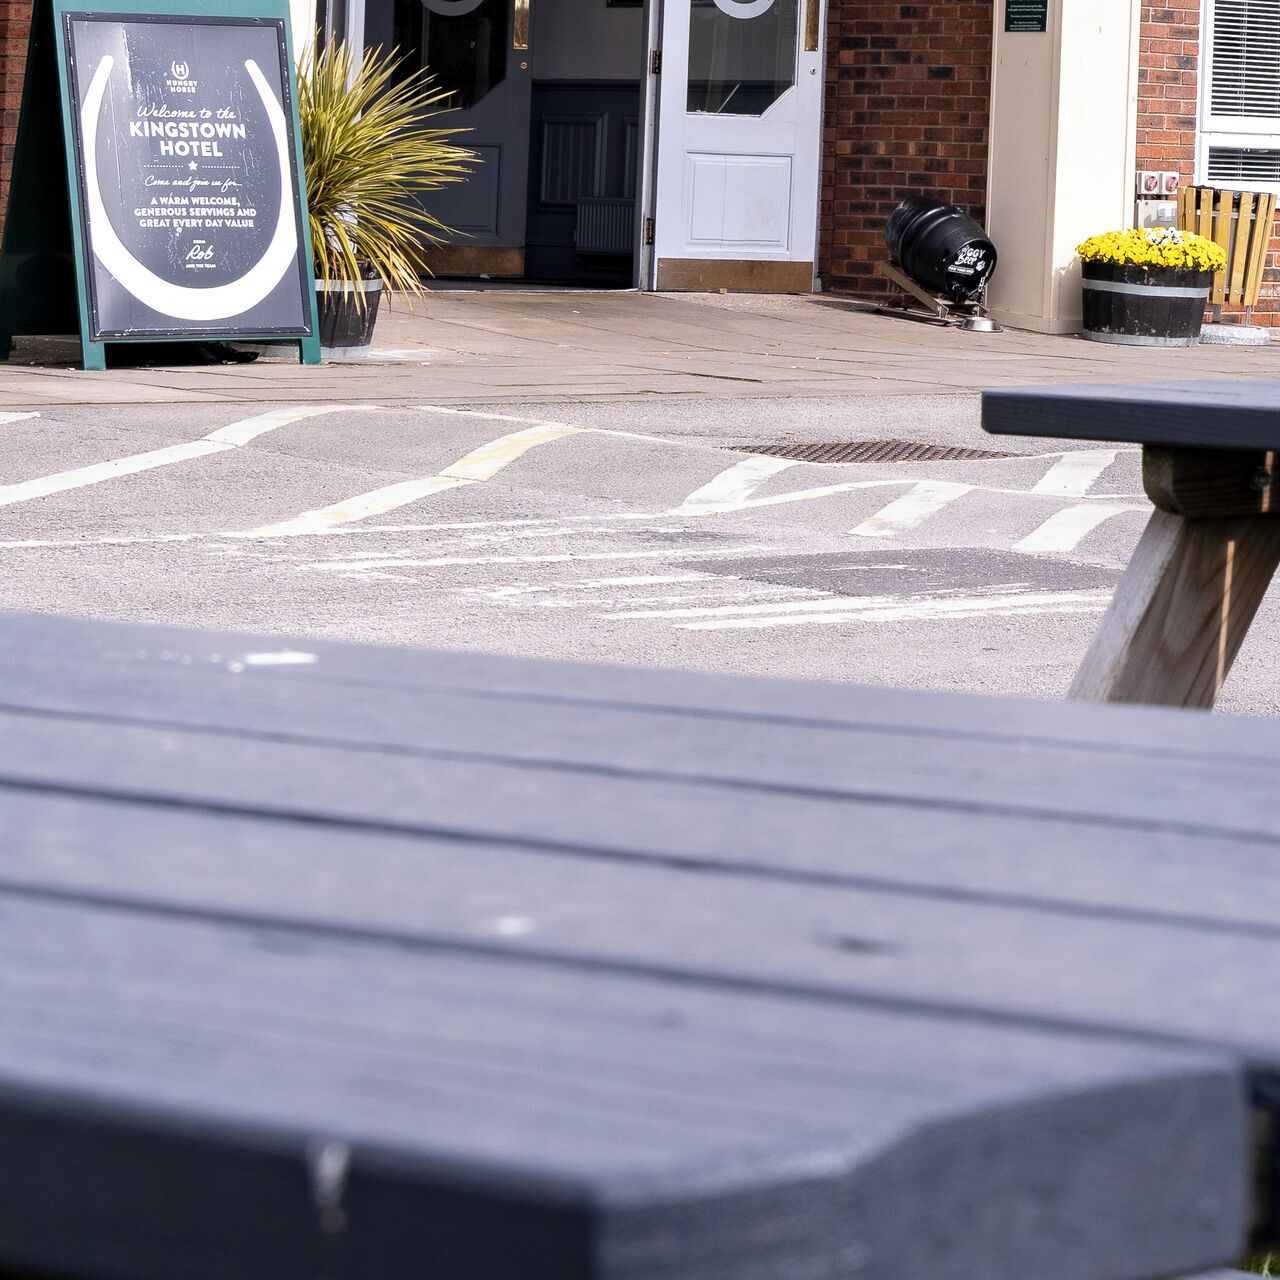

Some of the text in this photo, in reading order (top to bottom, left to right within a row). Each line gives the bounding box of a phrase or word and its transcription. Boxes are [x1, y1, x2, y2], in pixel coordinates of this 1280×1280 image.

[166, 79, 198, 87] HUNGRY
[137, 102, 237, 119] Welcome to the
[129, 121, 247, 139] KINGSTOWN
[159, 140, 224, 157] HOTEL
[144, 175, 171, 187] Come
[171, 176, 192, 186] and
[189, 177, 210, 193] join
[150, 197, 241, 208] A WARM WELCOME,
[133, 207, 257, 217] GENEROUS SERVINGS AND
[139, 219, 255, 228] GREAT EVERY DAY VALUE
[185, 244, 215, 260] Rob
